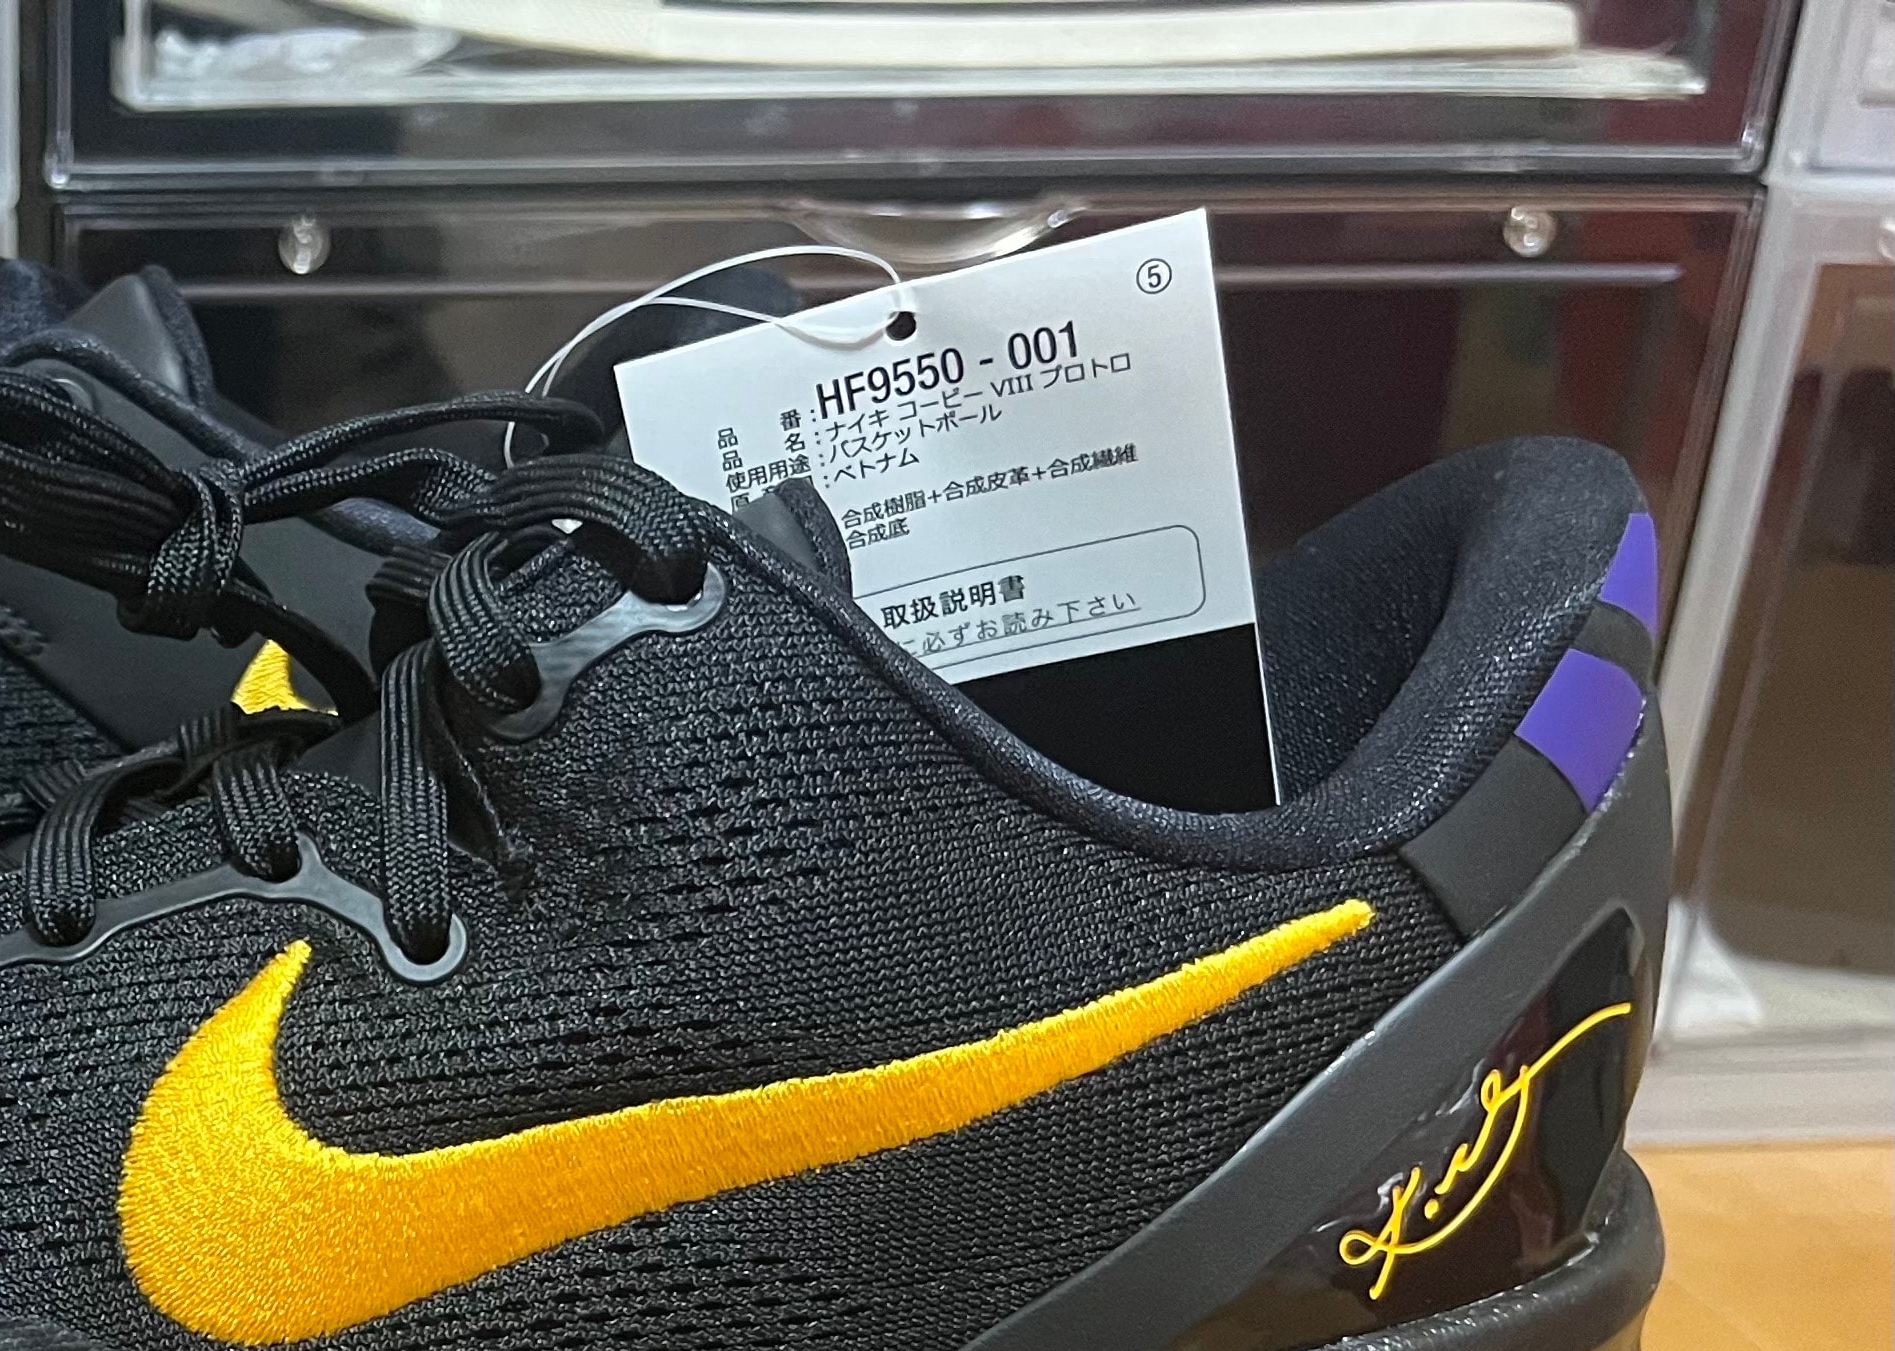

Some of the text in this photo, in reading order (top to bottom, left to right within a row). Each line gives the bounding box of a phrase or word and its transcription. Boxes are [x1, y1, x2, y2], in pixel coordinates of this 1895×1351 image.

[718, 427, 739, 449] 品
[816, 348, 965, 419] HF9550
[1007, 320, 1078, 370] 001
[722, 450, 744, 471] 品
[990, 374, 1034, 398] VIII
[1040, 353, 1131, 389] プロトロ
[834, 448, 920, 482] ベトナム
[846, 517, 910, 550] 合成底
[880, 575, 1025, 630] 取扱説明書
